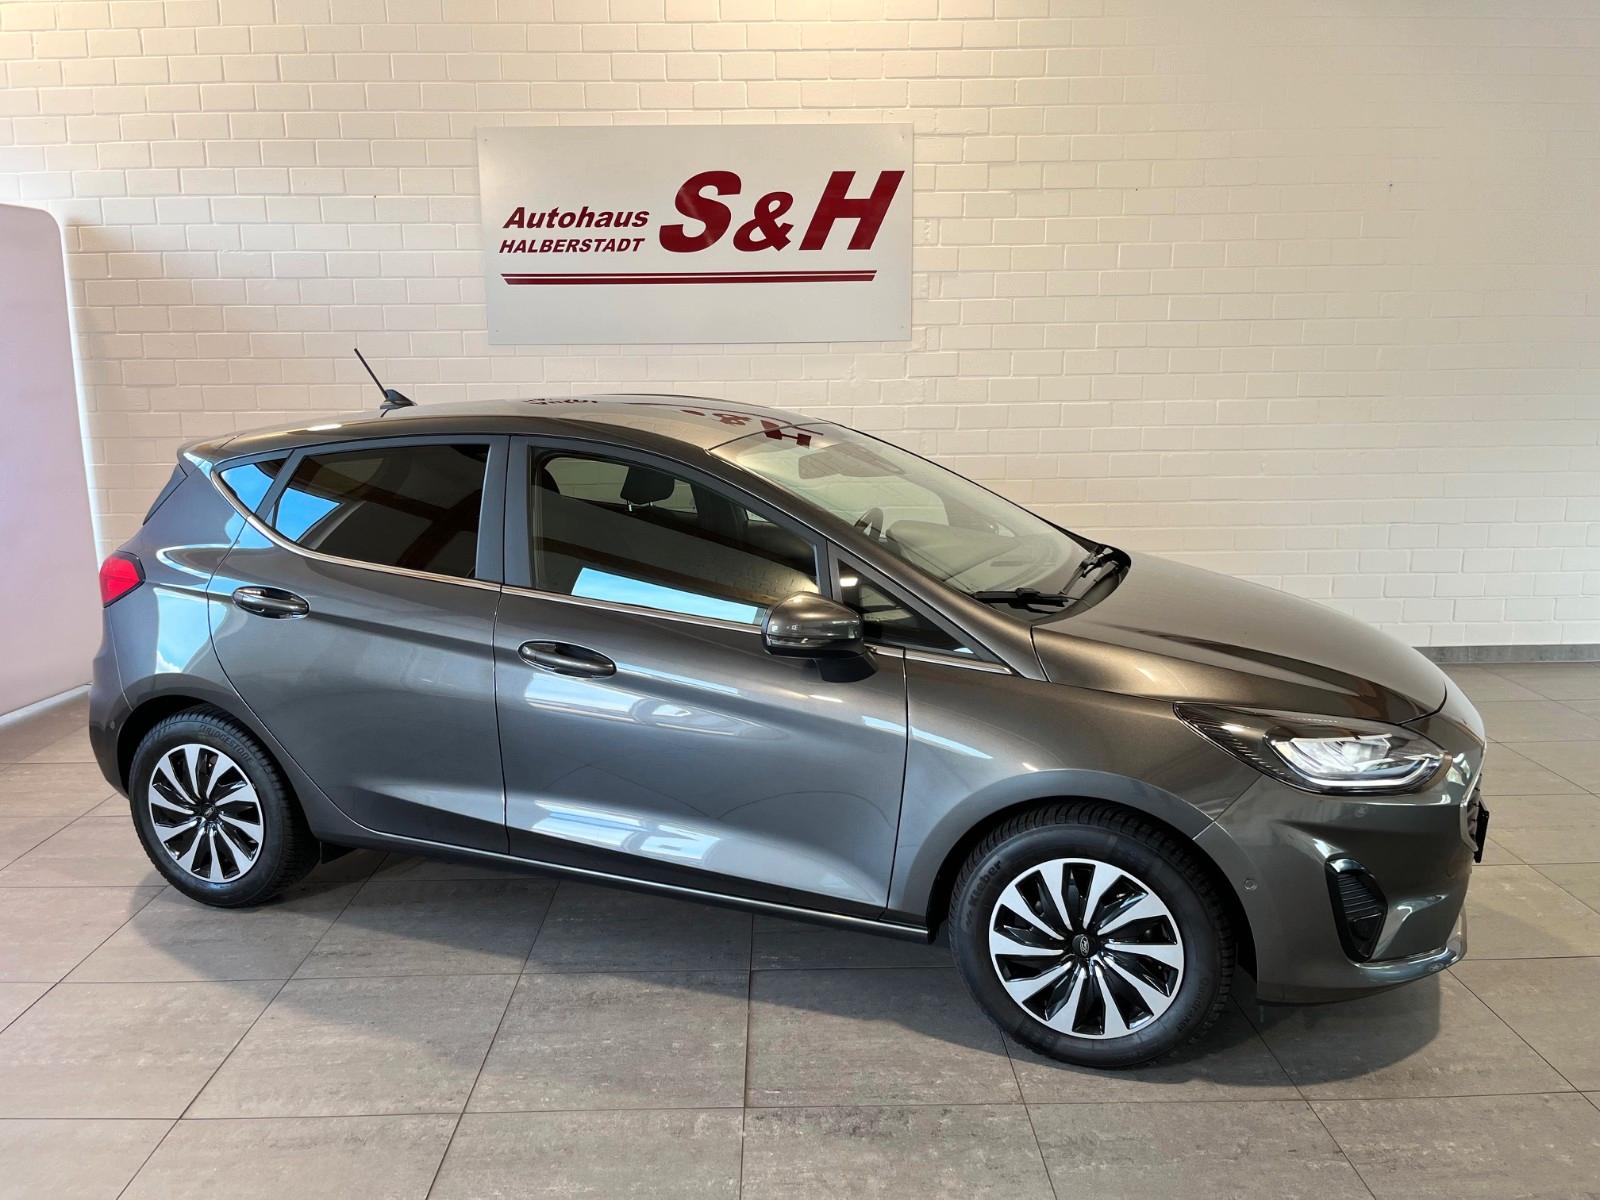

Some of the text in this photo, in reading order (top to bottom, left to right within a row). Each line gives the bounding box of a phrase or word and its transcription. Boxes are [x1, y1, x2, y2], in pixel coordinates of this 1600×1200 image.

[502, 206, 650, 229] Autohaus
[659, 170, 905, 253] S&H
[499, 238, 646, 254] HALBERSTADT
